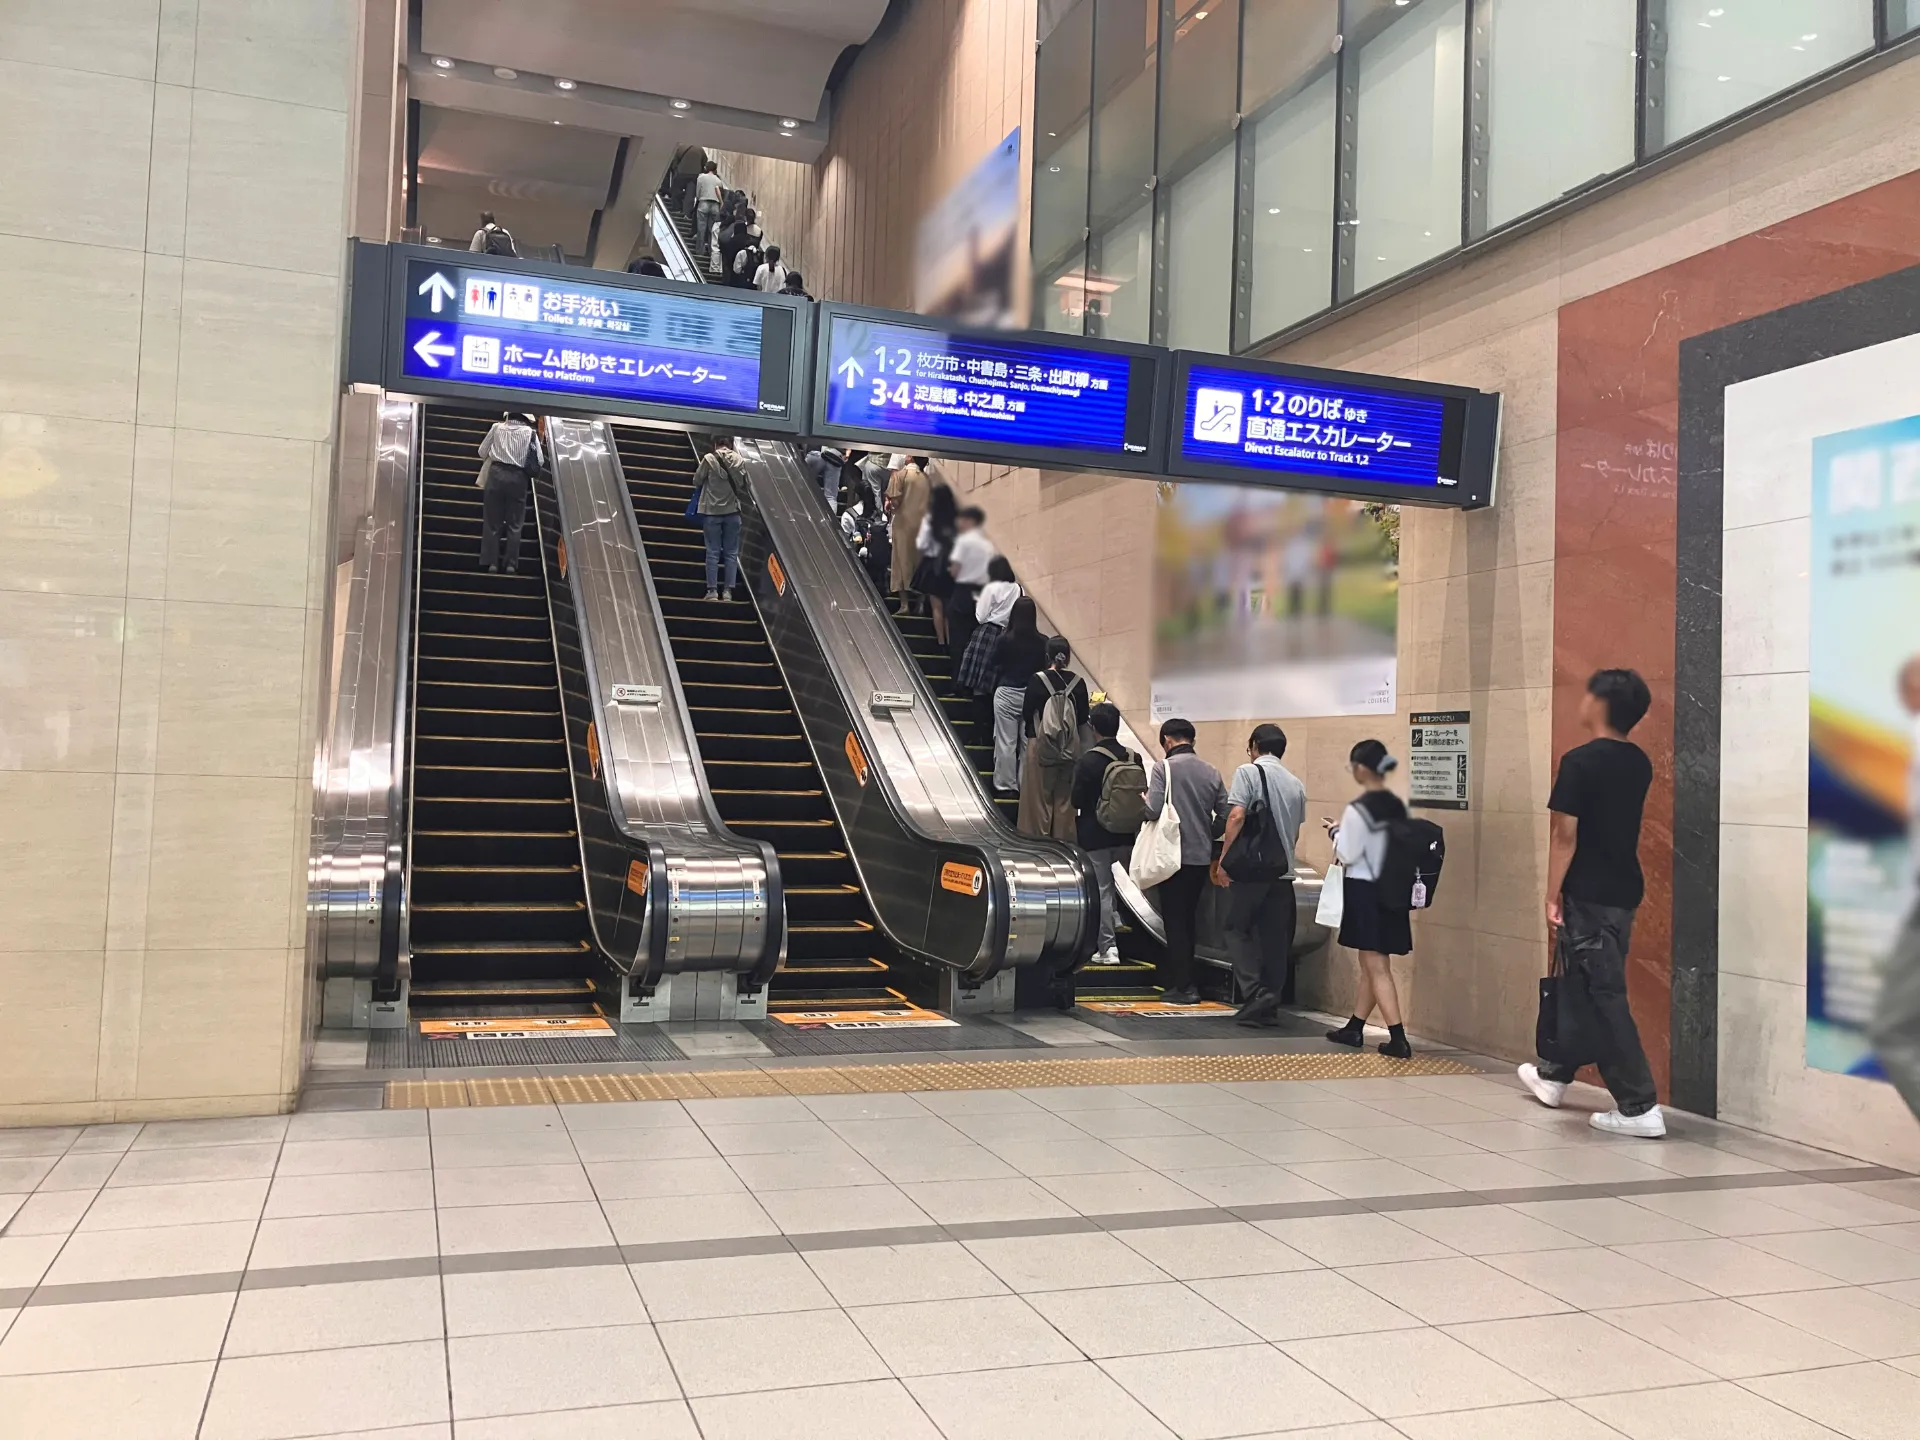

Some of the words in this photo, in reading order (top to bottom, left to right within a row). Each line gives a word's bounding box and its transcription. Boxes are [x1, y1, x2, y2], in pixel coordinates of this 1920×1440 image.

[543, 292, 620, 317] お手洗い
[542, 312, 574, 325] Toilets
[502, 364, 542, 377] Elevator
[543, 369, 554, 378] to
[555, 371, 596, 383] Platform
[503, 343, 728, 384] ホーム階ゆきエレベーター
[915, 369, 927, 378] for
[928, 371, 968, 383] Hirakatashi,
[968, 376, 1009, 388] Chushojima,
[1010, 382, 1030, 392] Sanjo,
[1031, 383, 1081, 398] Demachiyanagi
[913, 402, 925, 411] for
[925, 404, 970, 417] Yodoyabashi,
[970, 408, 1016, 421] Nakanoshima
[1246, 416, 1412, 452] 直通エスカレーター
[1244, 441, 1273, 455] Direct
[1273, 445, 1316, 459] Escalator
[1316, 450, 1328, 461] to
[1329, 451, 1354, 463] Track
[1355, 454, 1370, 466] 1,2
[1424, 729, 1458, 737] エスカレーターを
